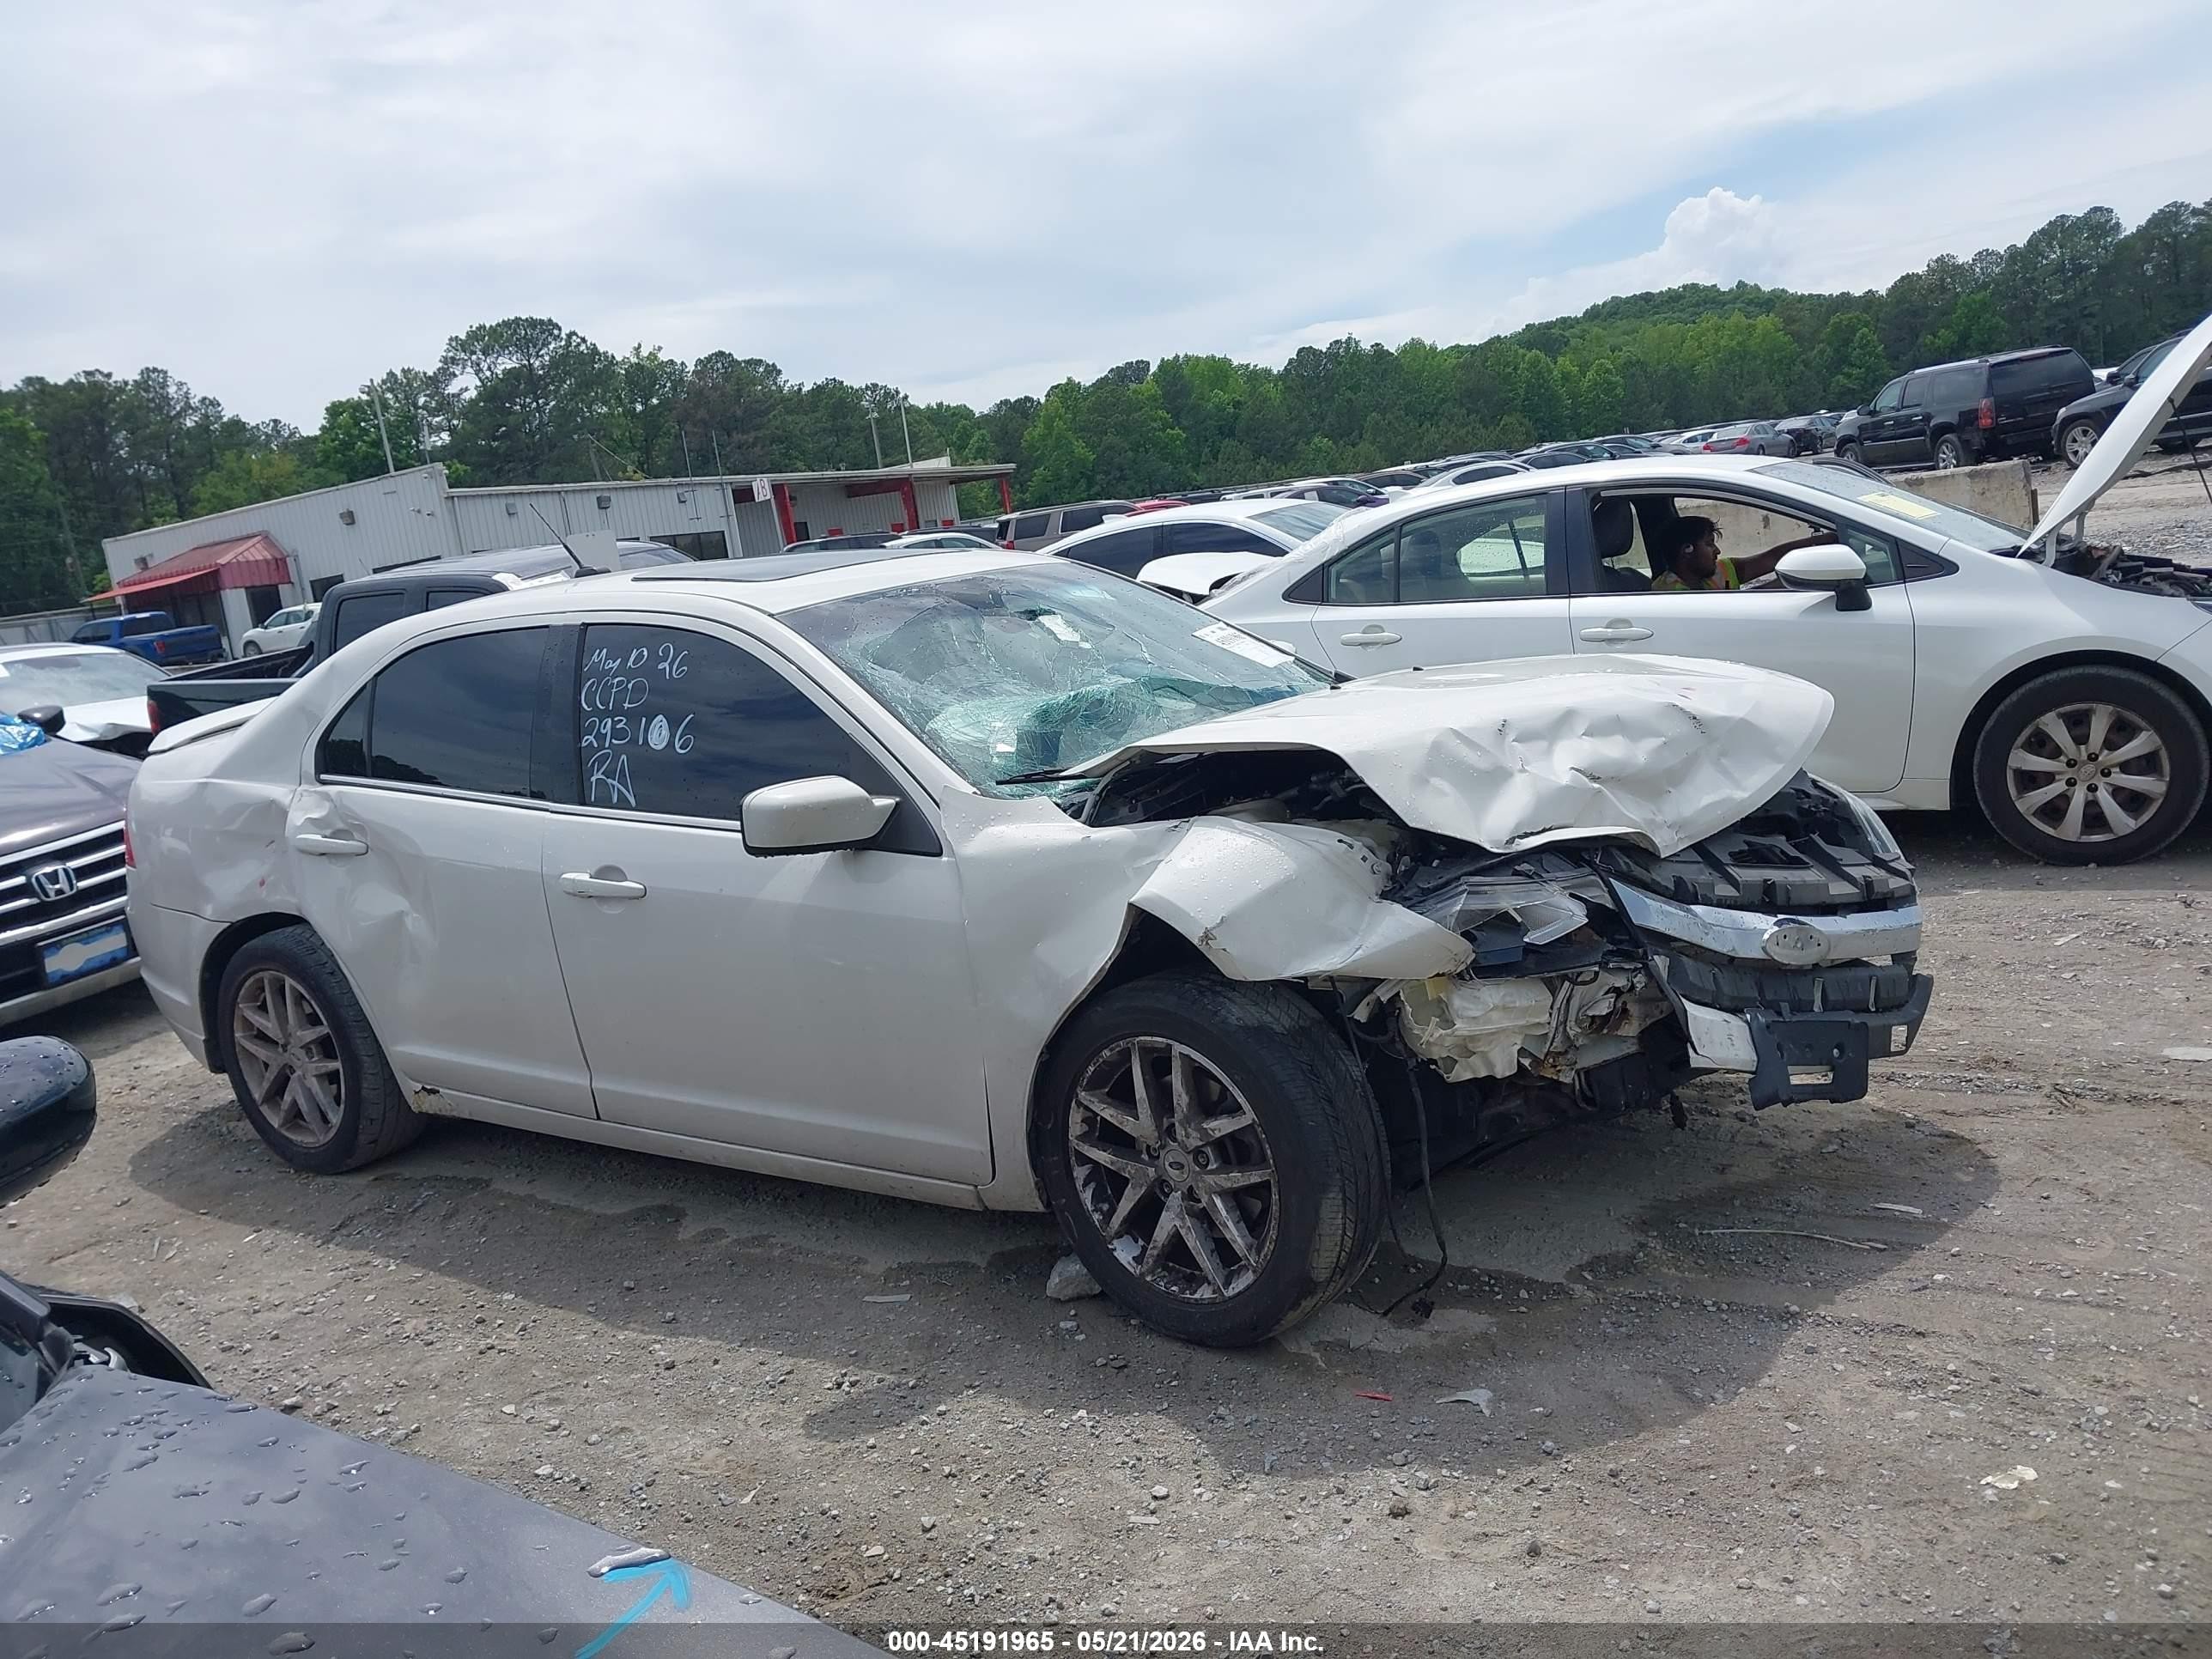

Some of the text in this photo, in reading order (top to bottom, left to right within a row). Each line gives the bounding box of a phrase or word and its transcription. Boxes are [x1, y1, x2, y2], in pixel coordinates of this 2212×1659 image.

[657, 642, 690, 680] 26
[580, 676, 649, 711] CCPD
[587, 749, 636, 808] RA
